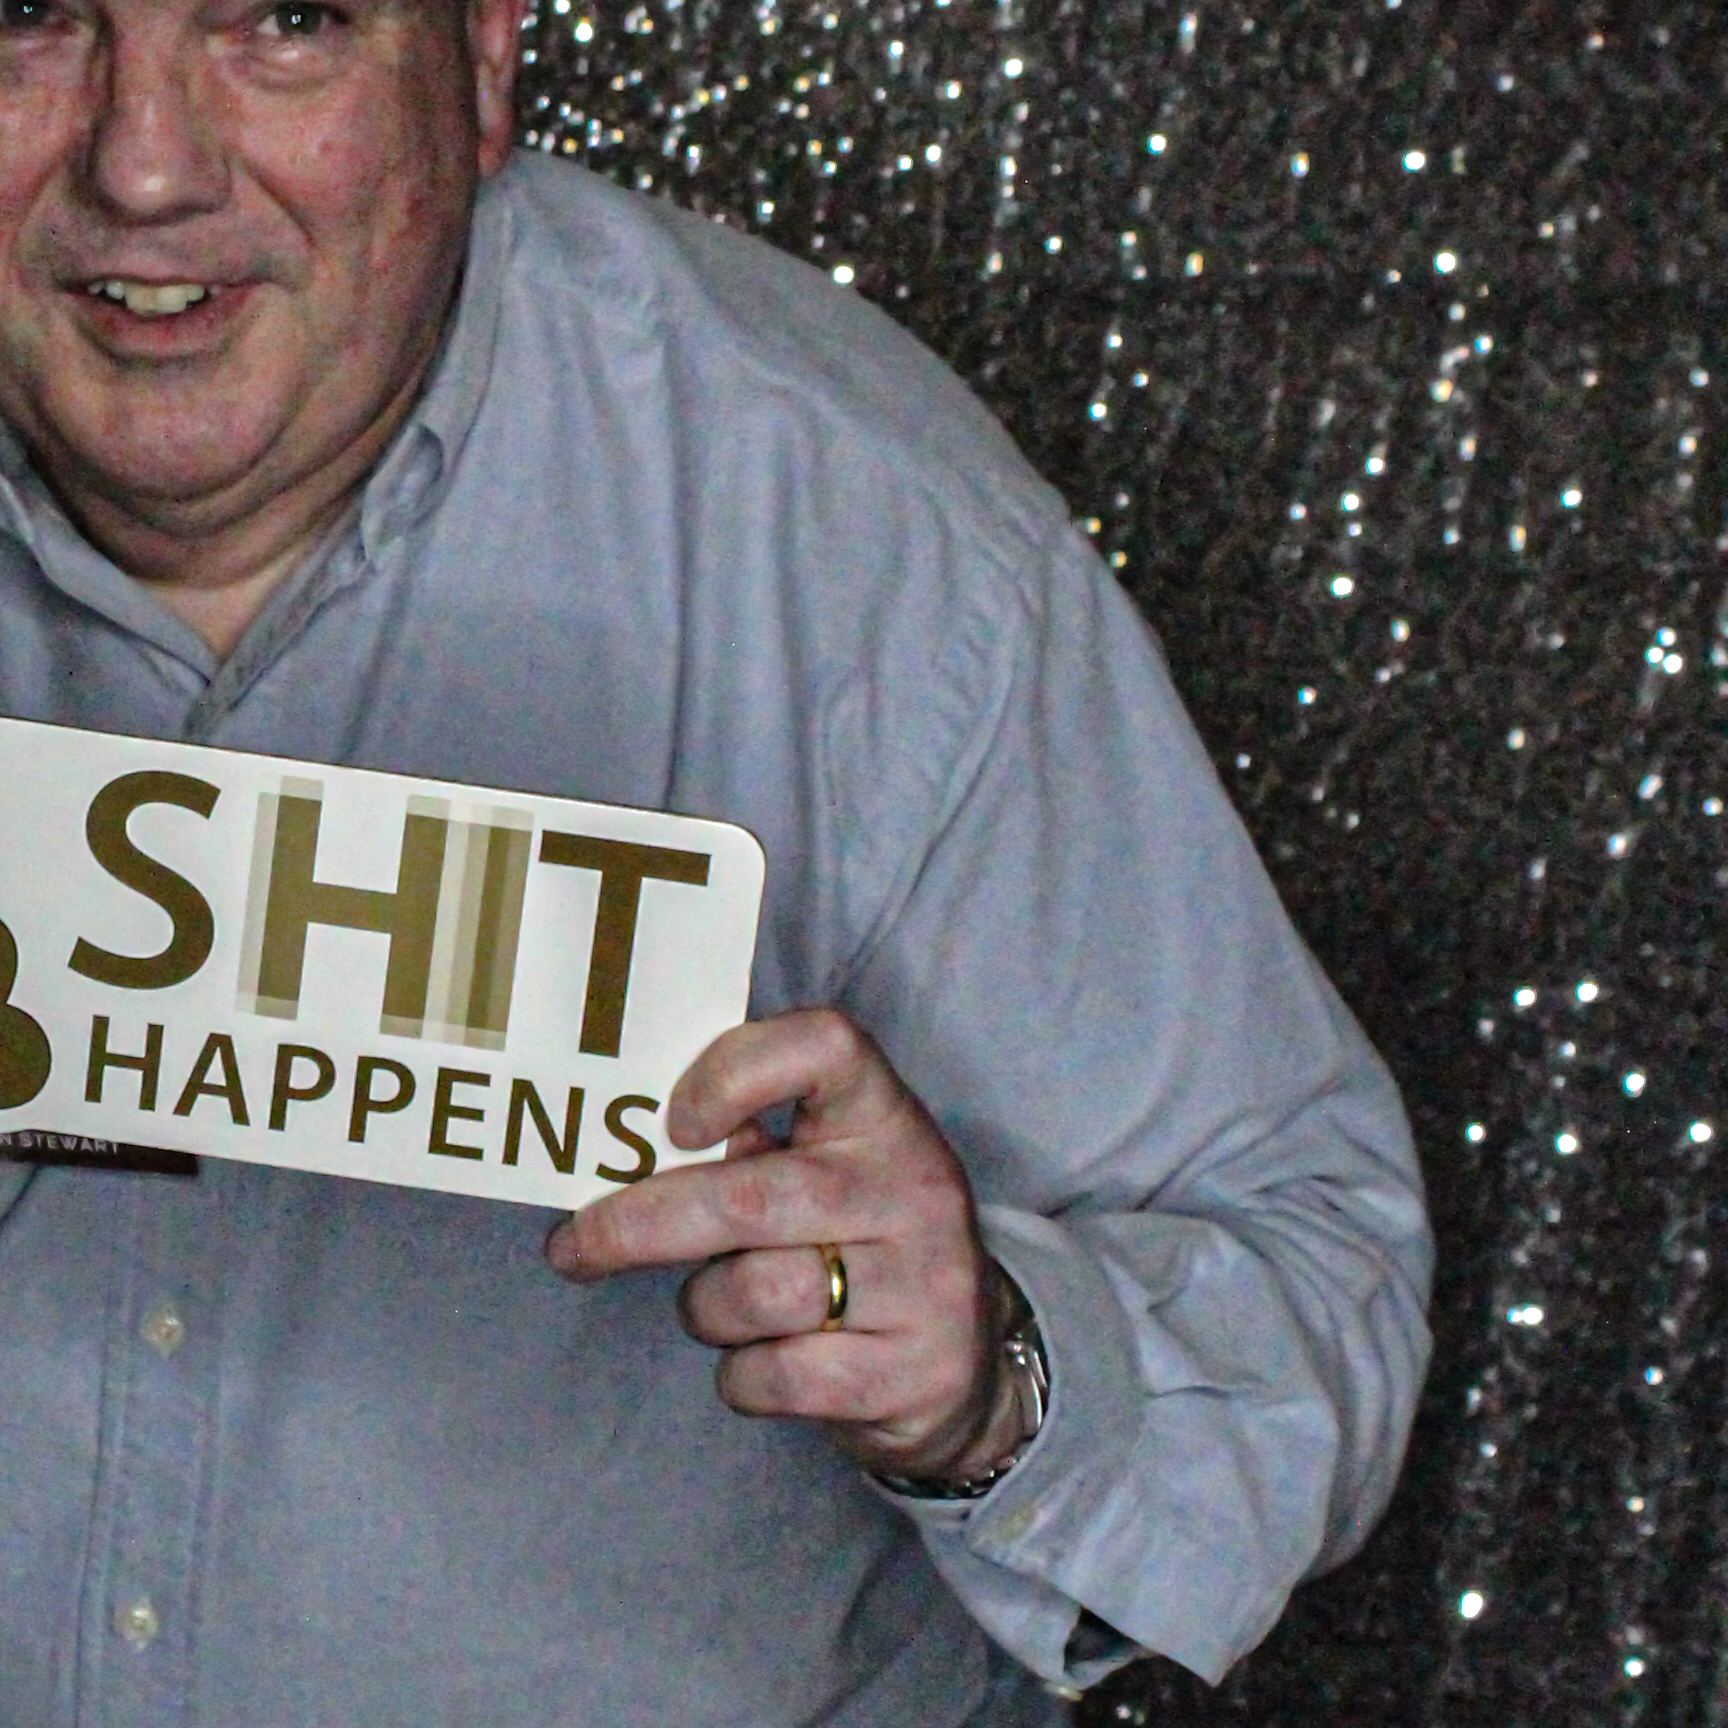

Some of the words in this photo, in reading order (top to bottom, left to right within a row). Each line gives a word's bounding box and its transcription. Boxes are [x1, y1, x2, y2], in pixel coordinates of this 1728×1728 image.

[68, 769, 712, 1060] SHIT
[18, 1132, 119, 1155] STEWART
[82, 1015, 660, 1184] HAPPENS
